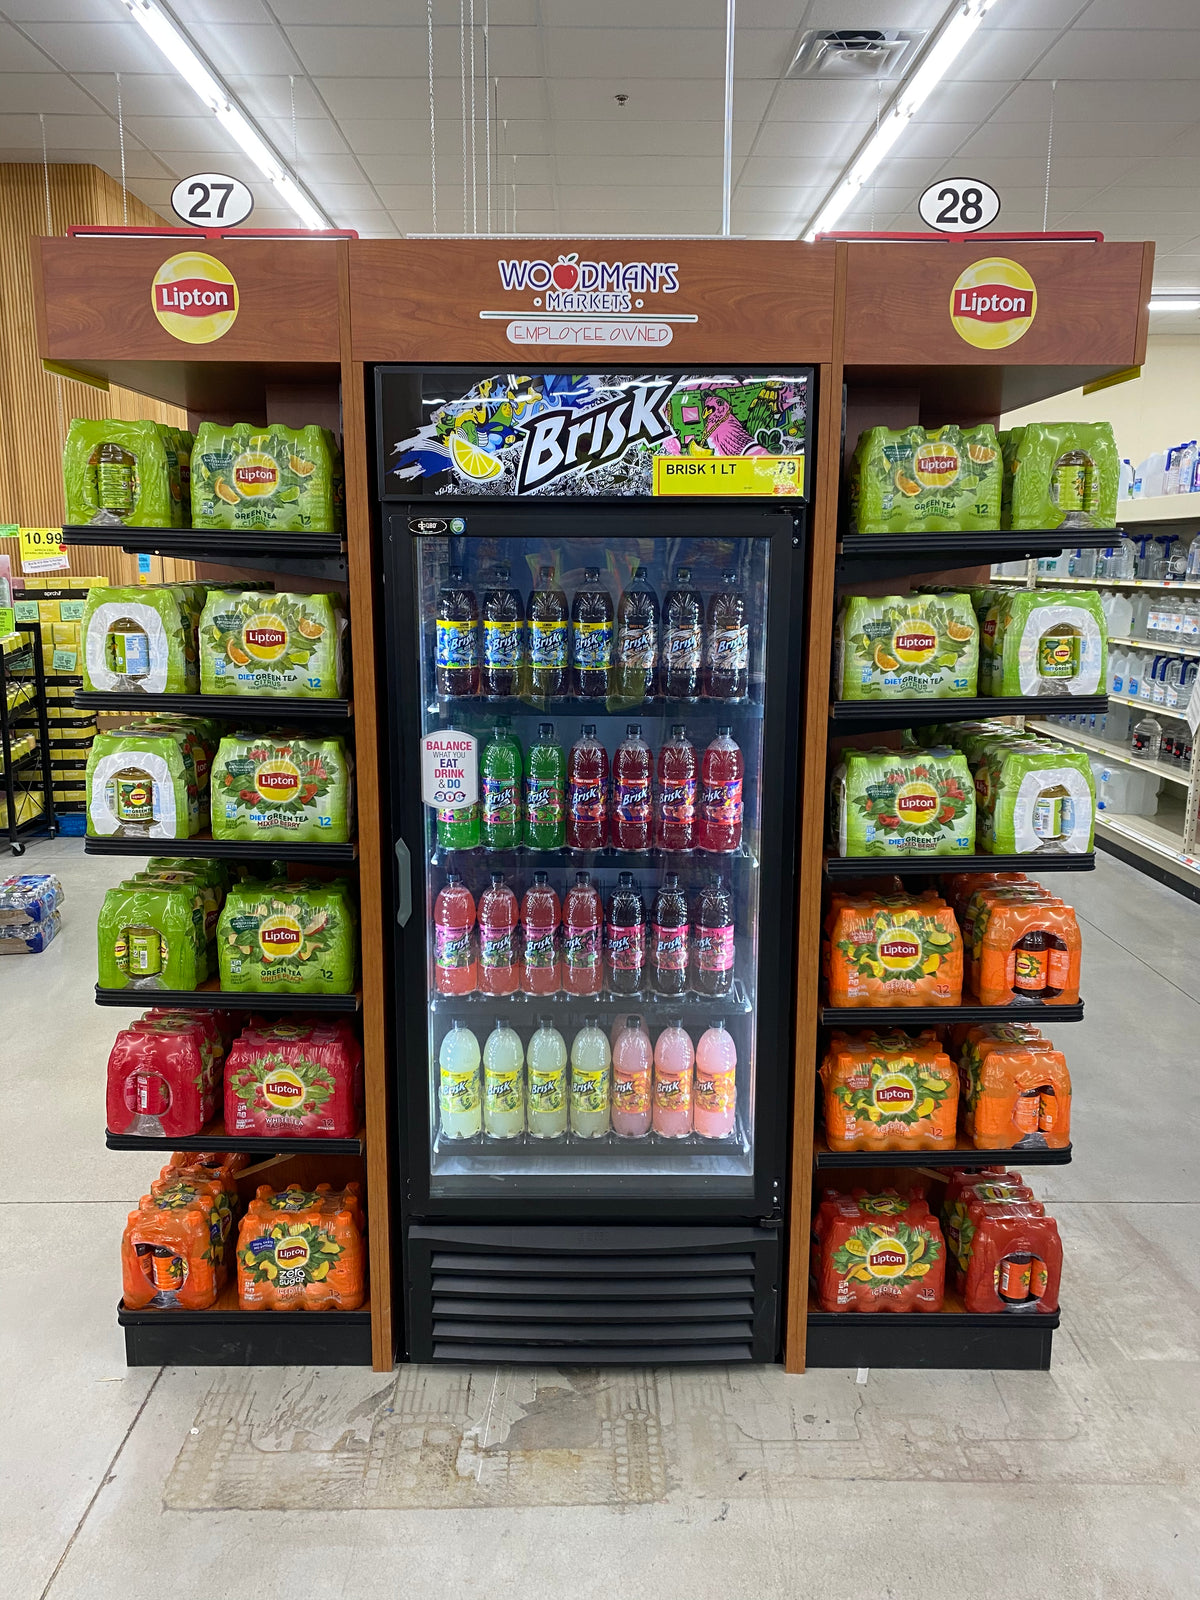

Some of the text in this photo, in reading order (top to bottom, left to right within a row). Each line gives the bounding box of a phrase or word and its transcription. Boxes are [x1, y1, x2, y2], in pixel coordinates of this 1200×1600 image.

[187, 183, 234, 218] 27
[935, 188, 983, 224] 28
[162, 286, 229, 310] Lipton
[547, 292, 631, 311] MARKETS
[959, 291, 1026, 315] Lipton
[514, 325, 669, 343] EMPLOYEE OWNED
[666, 464, 737, 475] BRISK 1 LT
[921, 459, 954, 471] Lipton
[239, 468, 274, 482] Lipton
[914, 499, 956, 510] GREEN TEA
[974, 503, 989, 514] 12
[234, 509, 262, 520] GREEN
[263, 510, 278, 520] TEA
[921, 506, 949, 517] CITRUS
[25, 532, 62, 545] 10.99
[249, 632, 282, 643] Lipton
[899, 637, 932, 649] Lipton
[254, 679, 281, 687] CITRUS
[255, 673, 281, 682] GREEN
[307, 677, 321, 688] 12
[902, 675, 928, 685] GREEN
[930, 676, 944, 685] TEA
[953, 678, 969, 688] 12
[426, 741, 472, 750] BALANCE
[440, 759, 458, 768] EAT
[434, 769, 464, 778] DRINK
[261, 775, 295, 787] Lipton
[439, 779, 461, 788] & DO
[901, 797, 934, 809] Lipton
[267, 812, 293, 821] GREEN
[295, 815, 309, 823] TEA
[318, 816, 331, 826] 12
[933, 834, 946, 843] TEA
[955, 837, 969, 847] 12
[264, 931, 296, 944] Lipton
[883, 945, 915, 957] Lipton
[260, 967, 302, 977] GREEN TEA
[320, 968, 334, 979] 12
[937, 984, 949, 994] 12
[269, 1084, 298, 1096] Lipton
[879, 1091, 909, 1103] Lipton
[930, 1126, 943, 1137] 12
[280, 1249, 305, 1259] Lipton
[873, 1254, 903, 1267] Lipton
[279, 1267, 306, 1279] zero
[279, 1277, 305, 1287] sugar
[922, 1288, 934, 1297] 12
